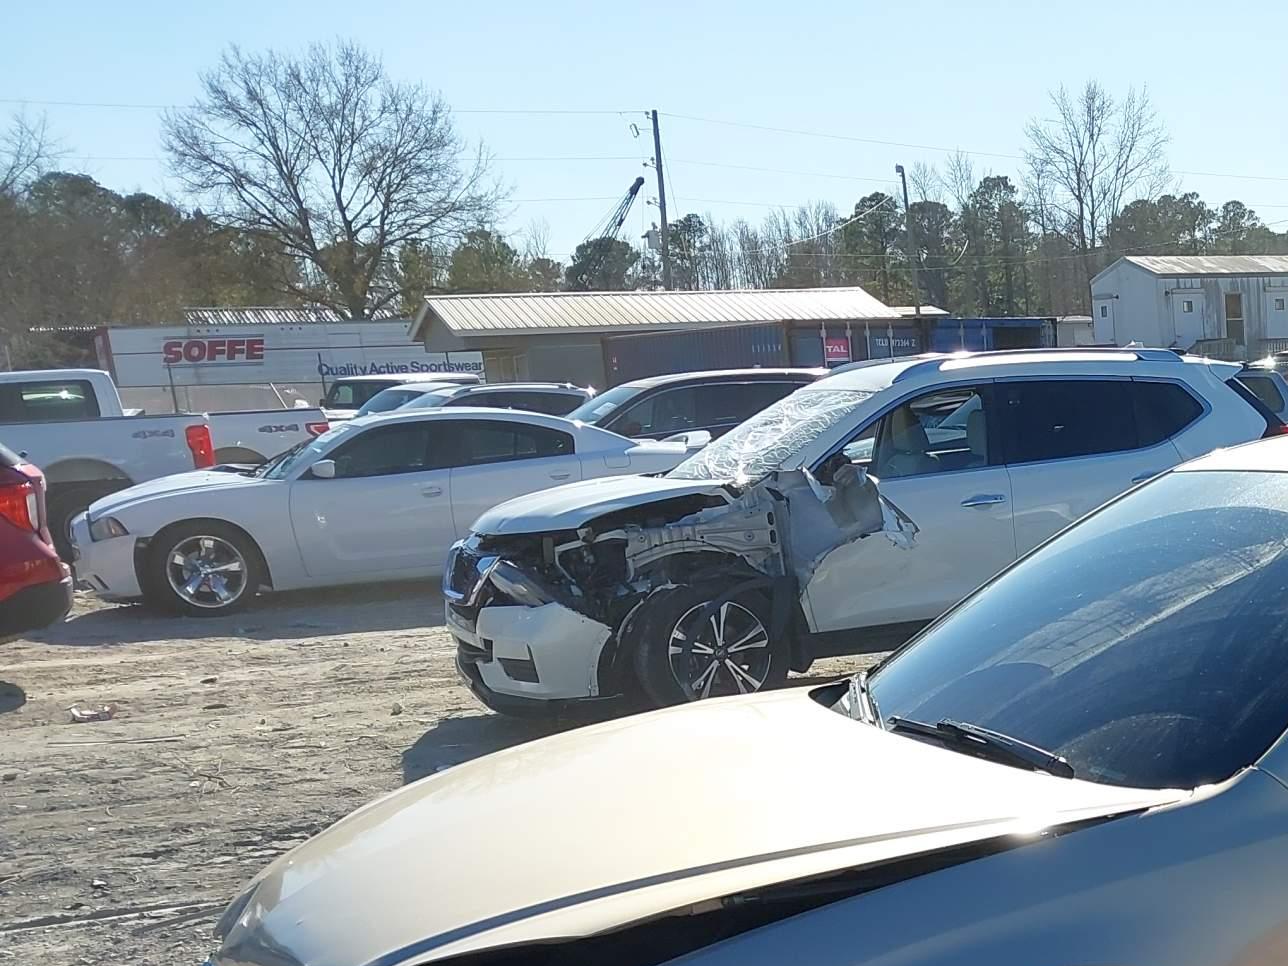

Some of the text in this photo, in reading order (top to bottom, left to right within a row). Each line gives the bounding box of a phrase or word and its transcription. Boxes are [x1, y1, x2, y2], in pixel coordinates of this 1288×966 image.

[163, 339, 264, 364] SOFFE
[826, 344, 848, 353] TAL
[318, 360, 482, 377] Quality Active Sportswear
